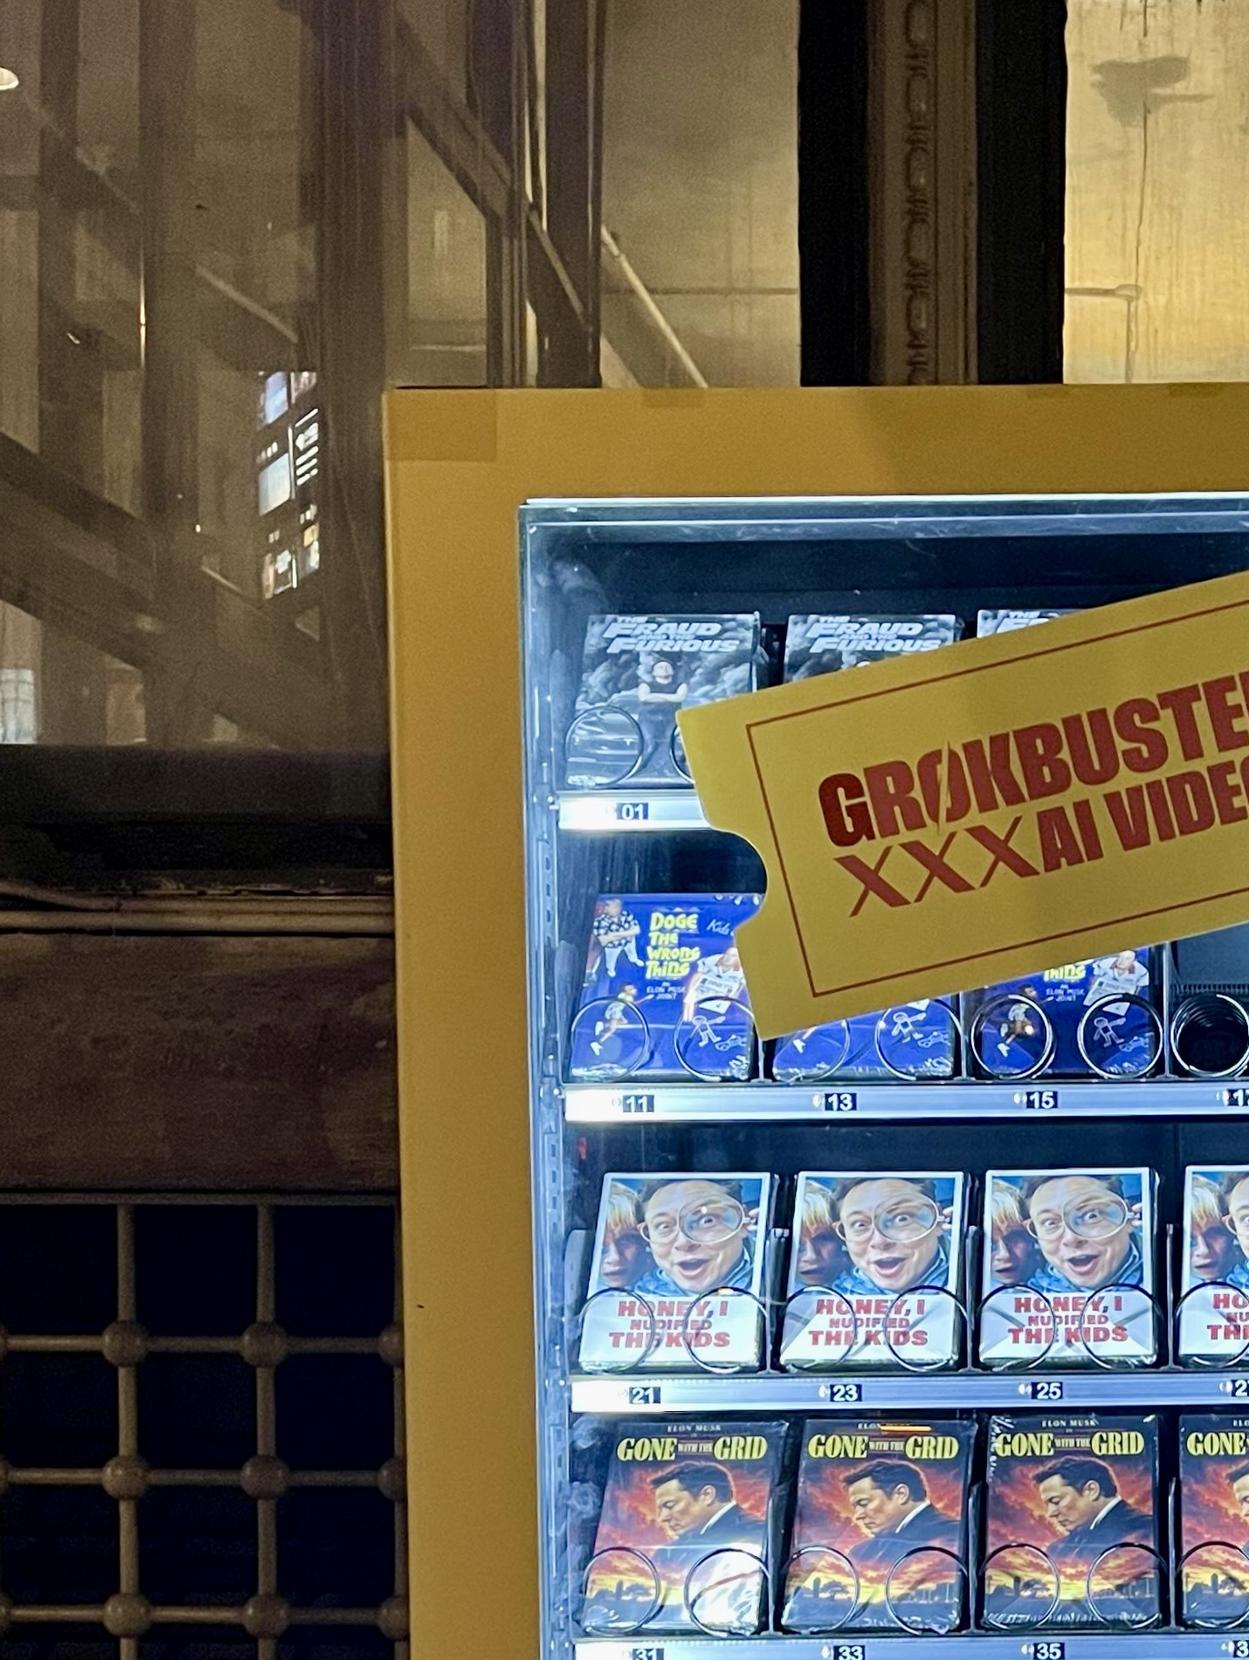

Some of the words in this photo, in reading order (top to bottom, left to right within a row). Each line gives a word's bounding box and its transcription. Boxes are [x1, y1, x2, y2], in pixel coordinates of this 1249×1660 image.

[603, 622, 722, 638] FRAUD
[806, 622, 923, 638] FRAUD
[606, 637, 740, 654] FURIOUS
[809, 637, 942, 654] FURIOUS
[621, 803, 644, 820] 01
[834, 816, 1041, 918] XXX
[1036, 799, 1104, 874] AI
[650, 912, 698, 931] DOGE
[649, 931, 679, 946] THE
[626, 1096, 648, 1112] 11
[829, 1093, 852, 1110] 13
[1031, 1091, 1054, 1109] 15
[719, 1301, 728, 1316] I
[816, 1299, 911, 1316] HONEY,
[917, 1299, 925, 1314] I
[1014, 1296, 1108, 1313] HONEY,
[1114, 1296, 1122, 1311] I
[1065, 1326, 1128, 1342] KIDS
[632, 1388, 654, 1404] 21
[833, 1385, 858, 1401] 23
[1037, 1382, 1061, 1400] 25
[617, 1438, 678, 1461] GONE
[713, 1436, 768, 1460] GRID
[807, 1434, 868, 1458] GONE
[905, 1435, 959, 1459] GRID
[995, 1432, 1054, 1456] GONE
[1091, 1431, 1145, 1455] GRID
[1186, 1432, 1246, 1456] GONE
[1036, 1643, 1061, 1660] 35
